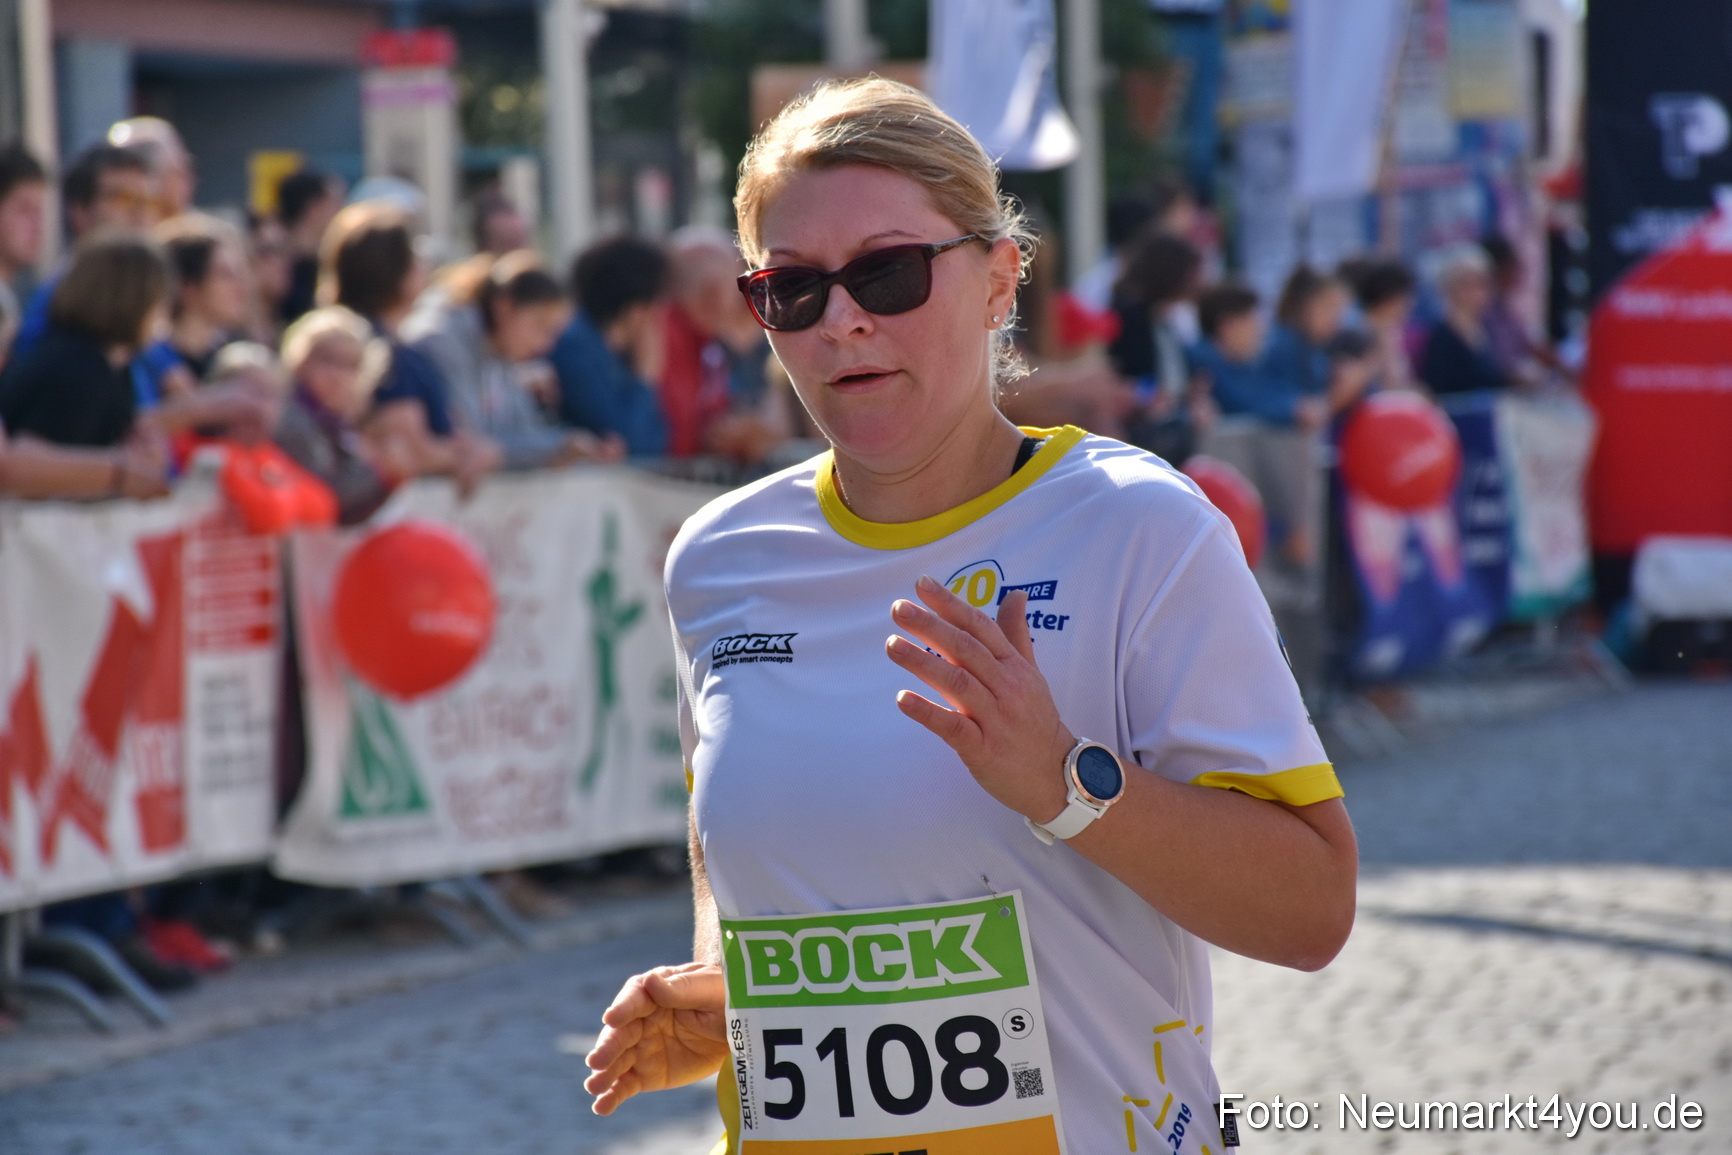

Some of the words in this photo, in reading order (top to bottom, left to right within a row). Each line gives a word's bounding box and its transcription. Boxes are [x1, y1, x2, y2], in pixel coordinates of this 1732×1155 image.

[713, 633, 798, 660] BOCK
[739, 656, 759, 664] smart
[760, 656, 793, 664] concepts
[738, 914, 1000, 995] BOCK
[1010, 1015, 1026, 1032] S
[763, 1015, 1009, 1120] 5108
